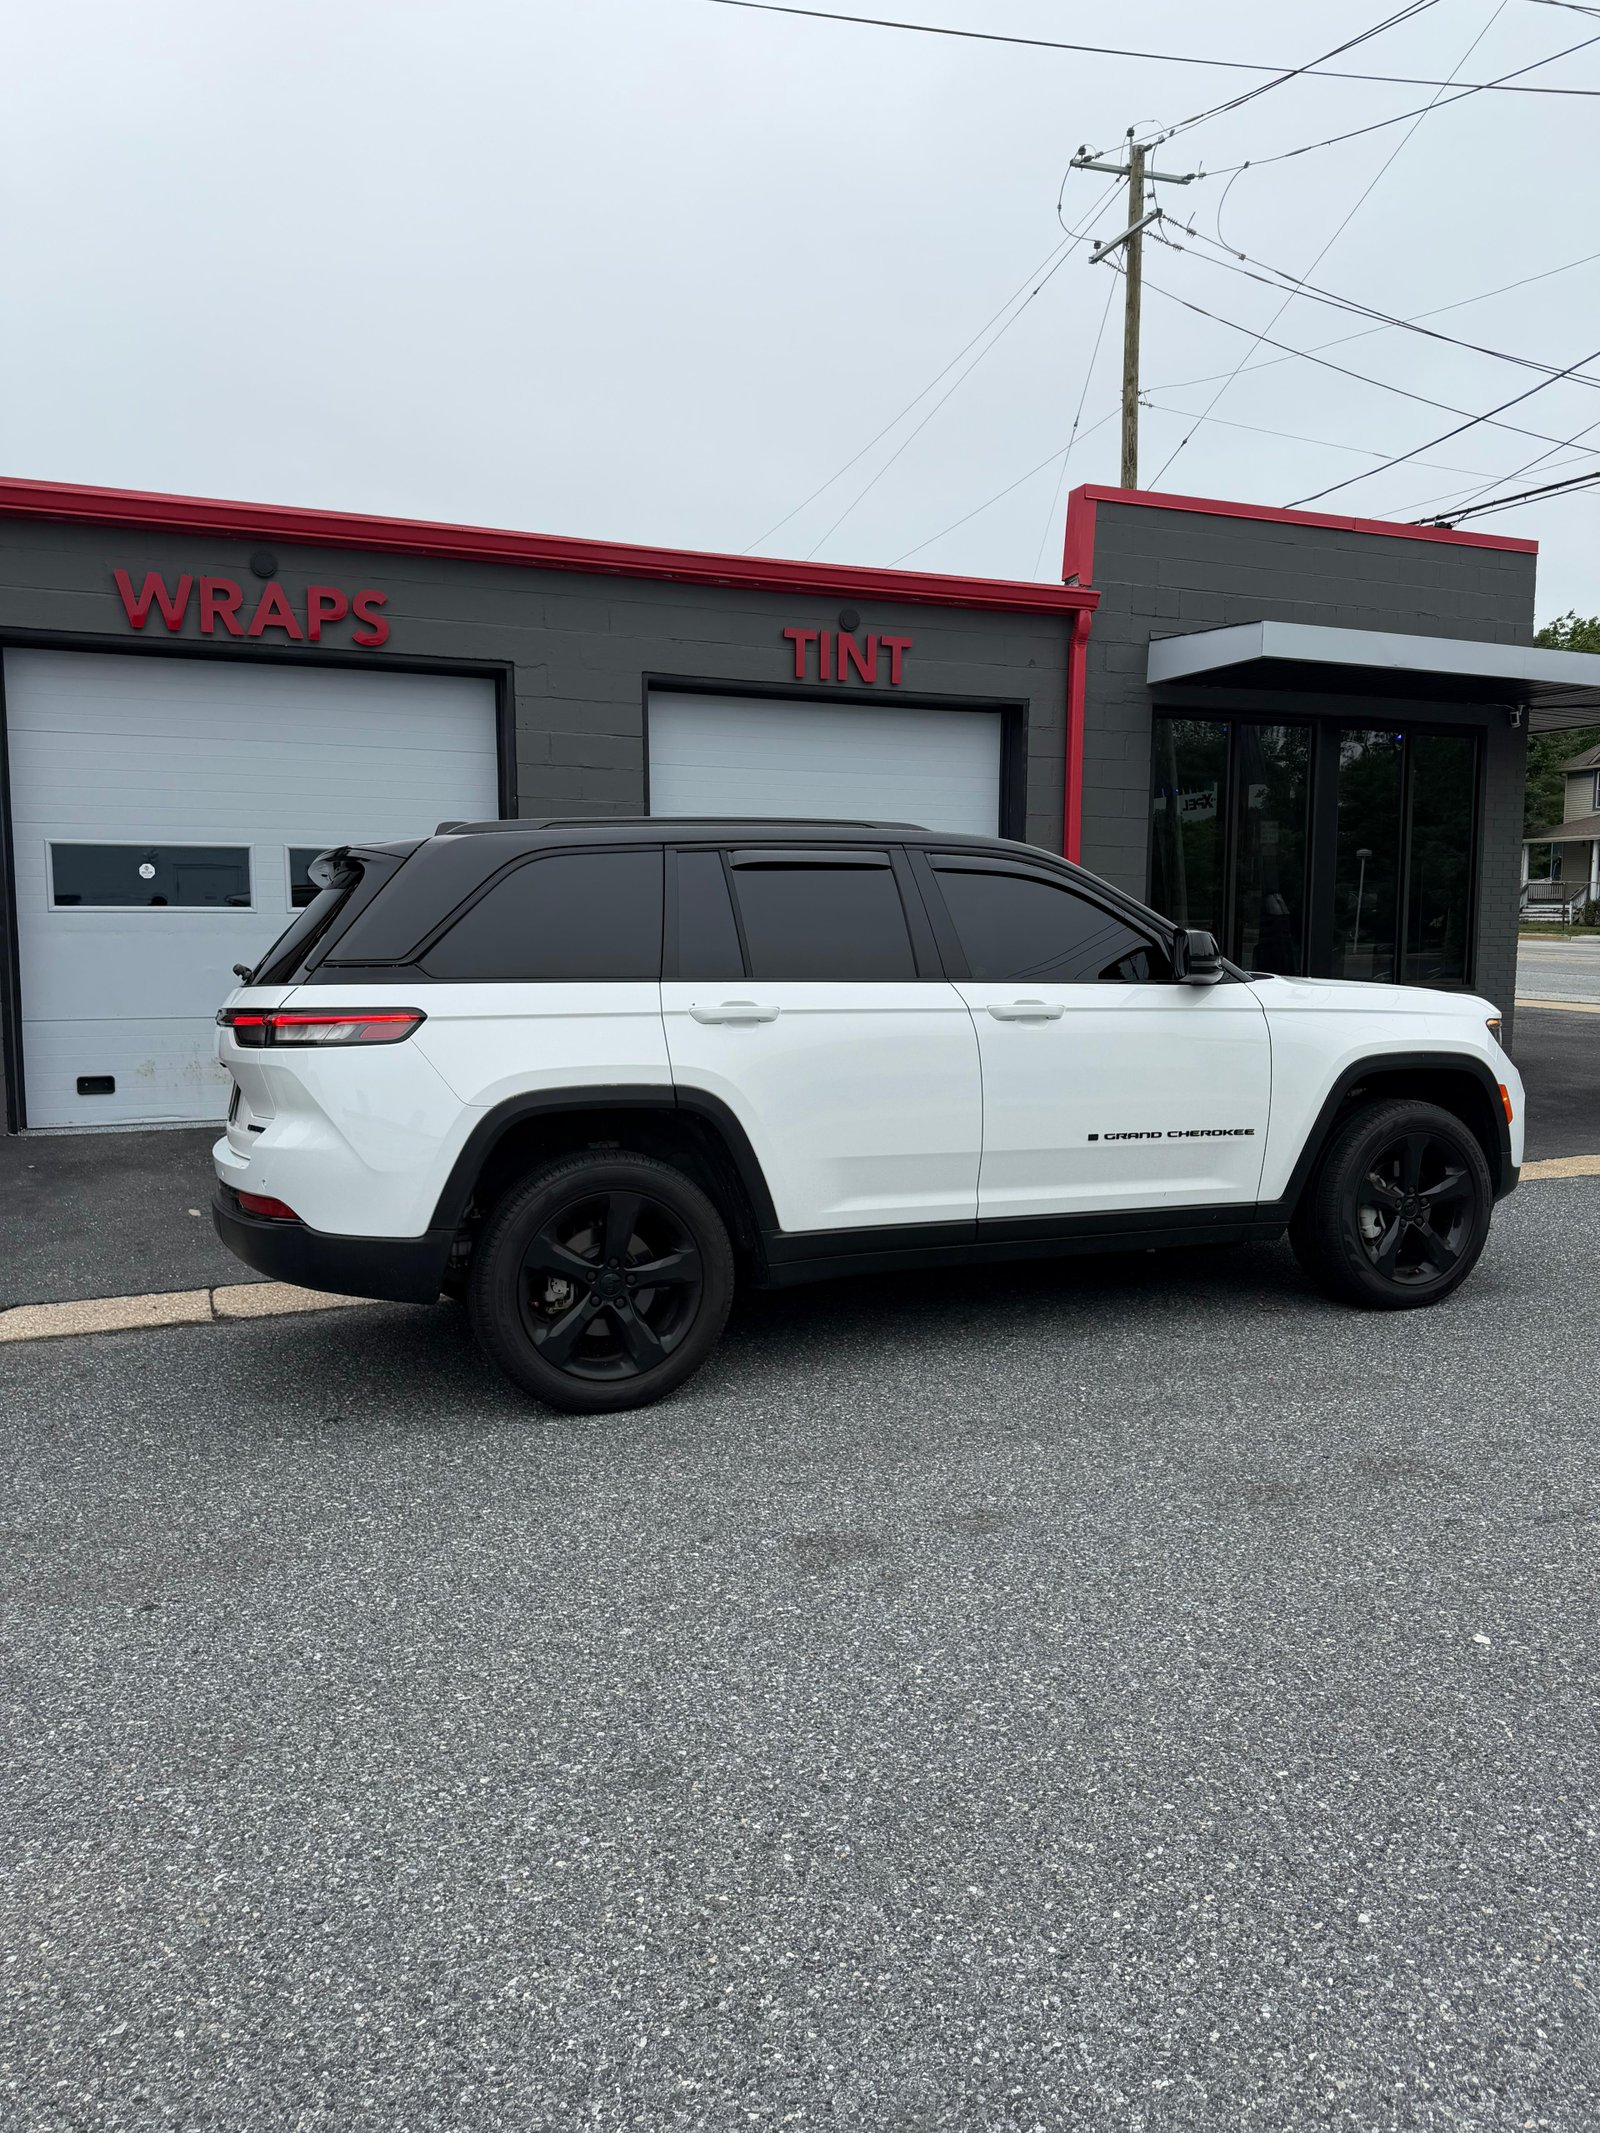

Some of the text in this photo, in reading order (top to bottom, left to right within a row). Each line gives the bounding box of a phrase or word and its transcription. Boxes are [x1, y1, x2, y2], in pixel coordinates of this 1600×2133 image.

[113, 568, 390, 646] WRAPS
[783, 627, 913, 685] TINT
[1103, 1128, 1256, 1141] GRAND CHEROKEE
